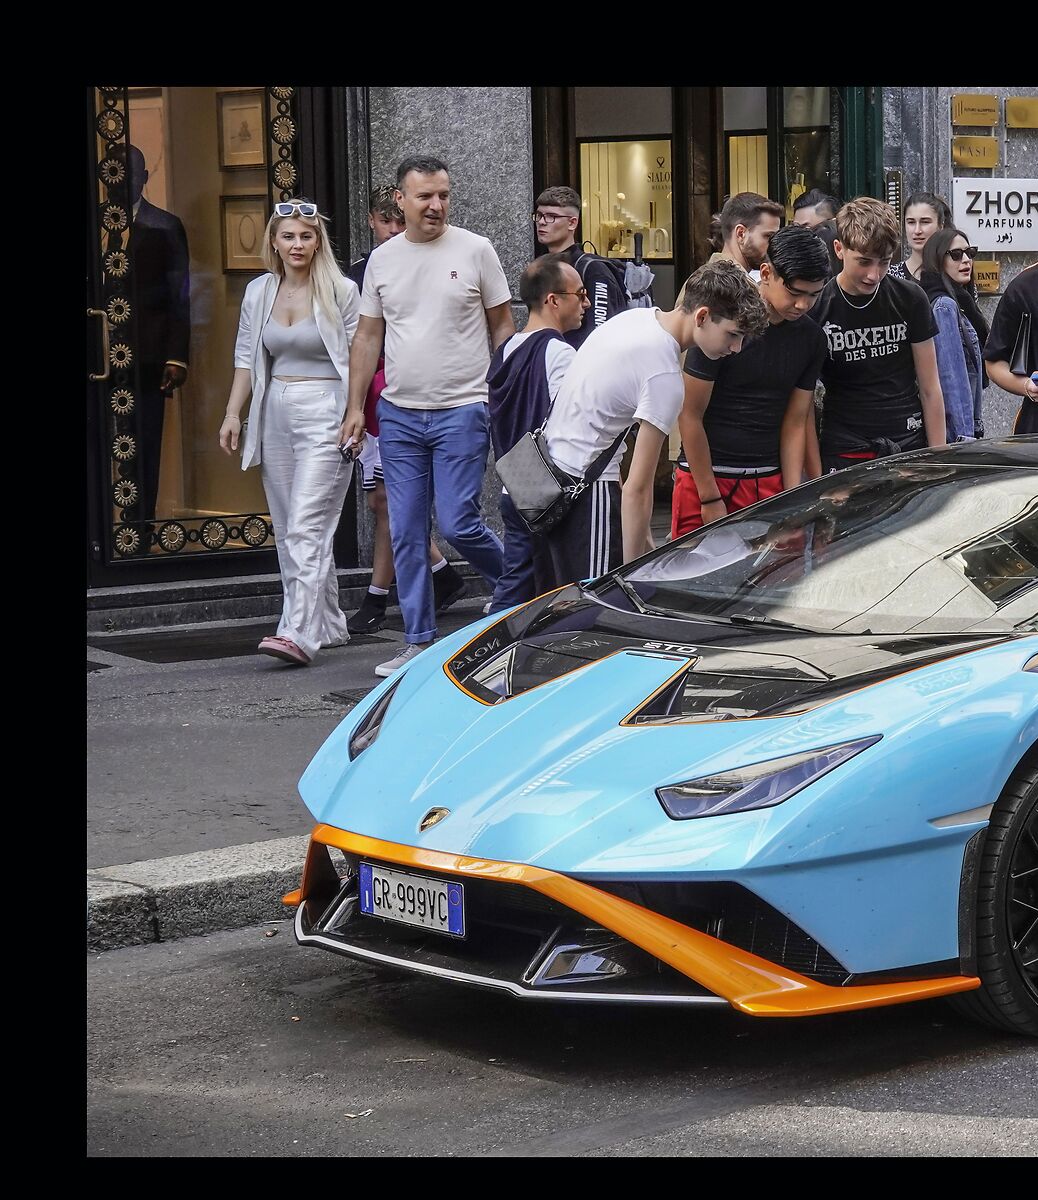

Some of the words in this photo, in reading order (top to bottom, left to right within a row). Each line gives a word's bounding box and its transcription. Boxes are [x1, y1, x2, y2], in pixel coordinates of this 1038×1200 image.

[648, 172, 671, 182] SIALO
[978, 218, 1033, 229] PARFUMS
[977, 272, 998, 280] FANTI
[832, 323, 908, 352] BOXEUR
[845, 349, 867, 362] DES
[871, 343, 899, 358] RUES
[643, 642, 698, 653] STO
